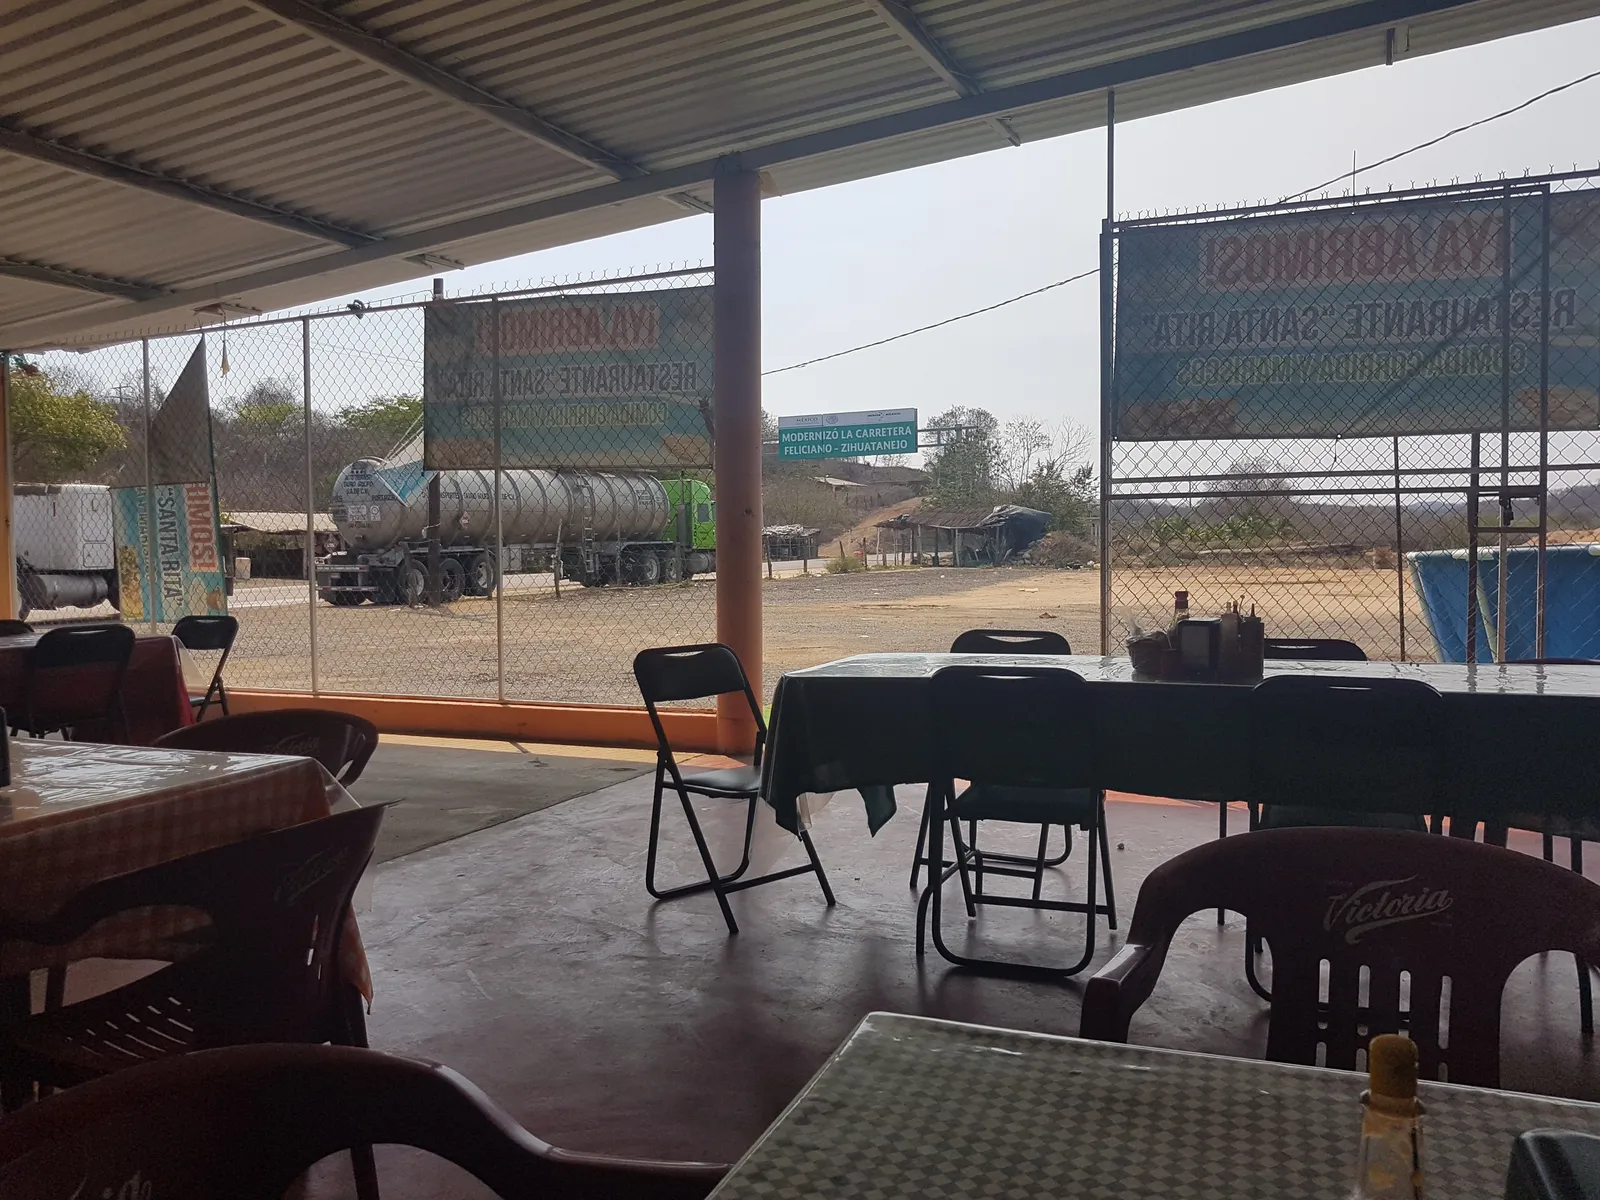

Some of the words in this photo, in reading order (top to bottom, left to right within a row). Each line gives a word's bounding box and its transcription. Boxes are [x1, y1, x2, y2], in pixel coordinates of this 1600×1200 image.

[782, 428, 839, 443] MODERNIZÓ
[841, 430, 853, 439] LA
[855, 425, 912, 438] CARRETERA
[784, 444, 833, 455] FELICIANO
[841, 440, 908, 453] ZIHUATANEJO
[1323, 876, 1453, 943] Victoria
